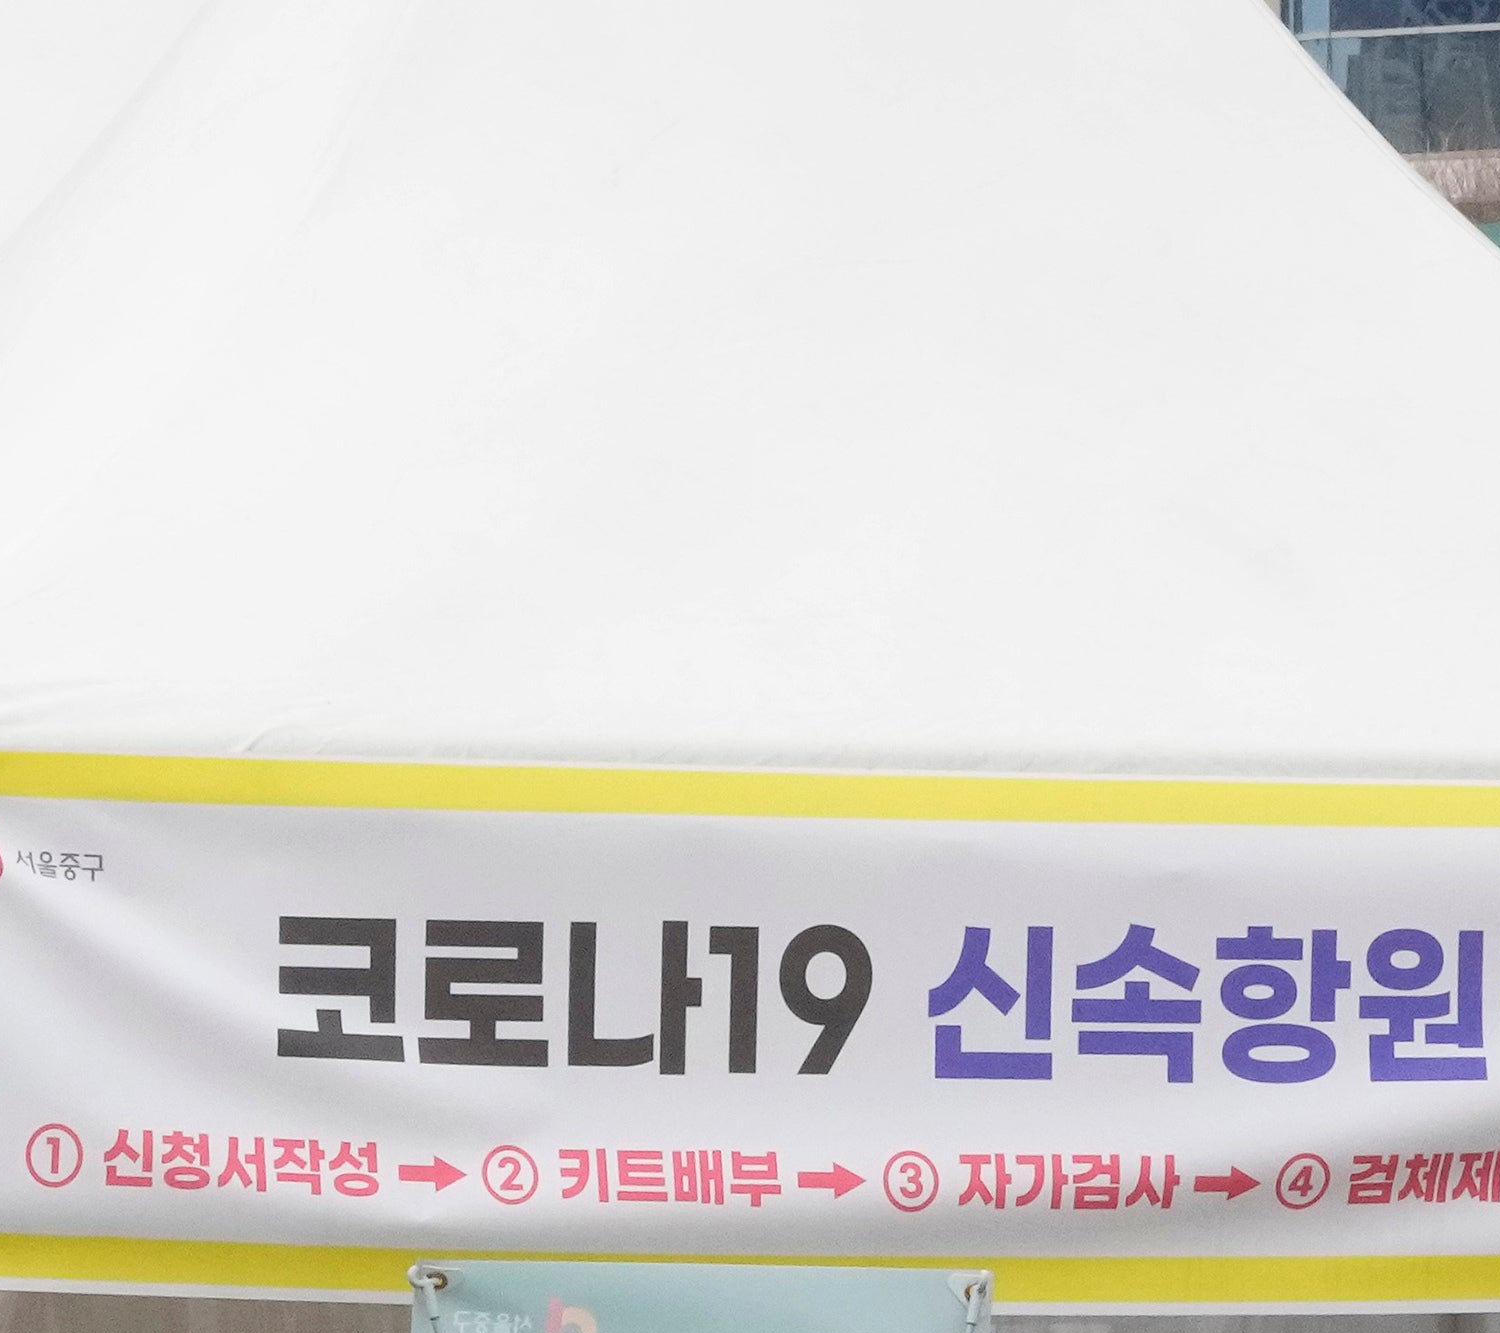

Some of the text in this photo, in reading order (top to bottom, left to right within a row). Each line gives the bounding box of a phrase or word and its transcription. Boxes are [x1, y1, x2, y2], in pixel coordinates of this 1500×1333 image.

[14, 848, 106, 883] 서울중구
[276, 914, 875, 1077] 코로나19
[104, 1129, 381, 1197] 신청서작성
[559, 1148, 783, 1207] 키트배부
[959, 1153, 1182, 1210] 자가검사
